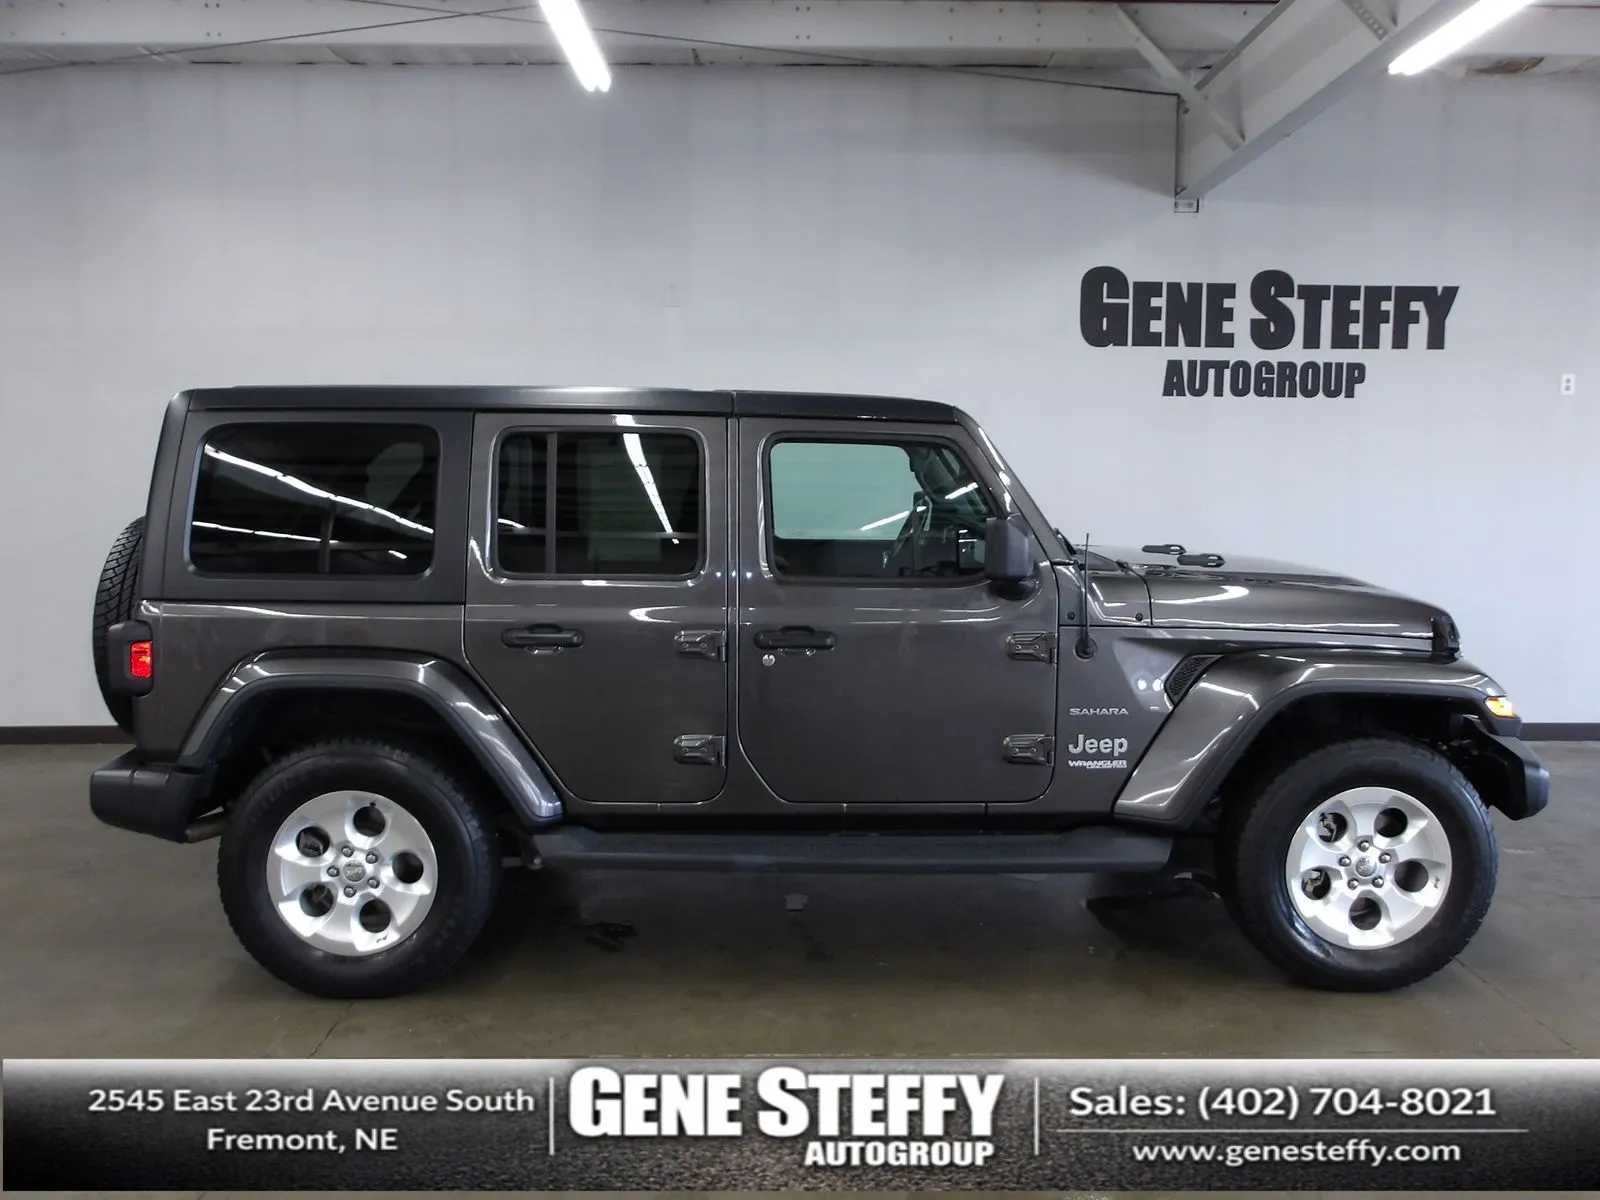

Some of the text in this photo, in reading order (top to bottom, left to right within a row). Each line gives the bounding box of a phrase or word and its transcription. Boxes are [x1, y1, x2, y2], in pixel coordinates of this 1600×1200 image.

[1080, 265, 1460, 350] GENE STEFFY
[1162, 360, 1366, 398] AUTOGROUP
[1069, 707, 1129, 716] SAHARA
[1068, 733, 1128, 757] Jeep
